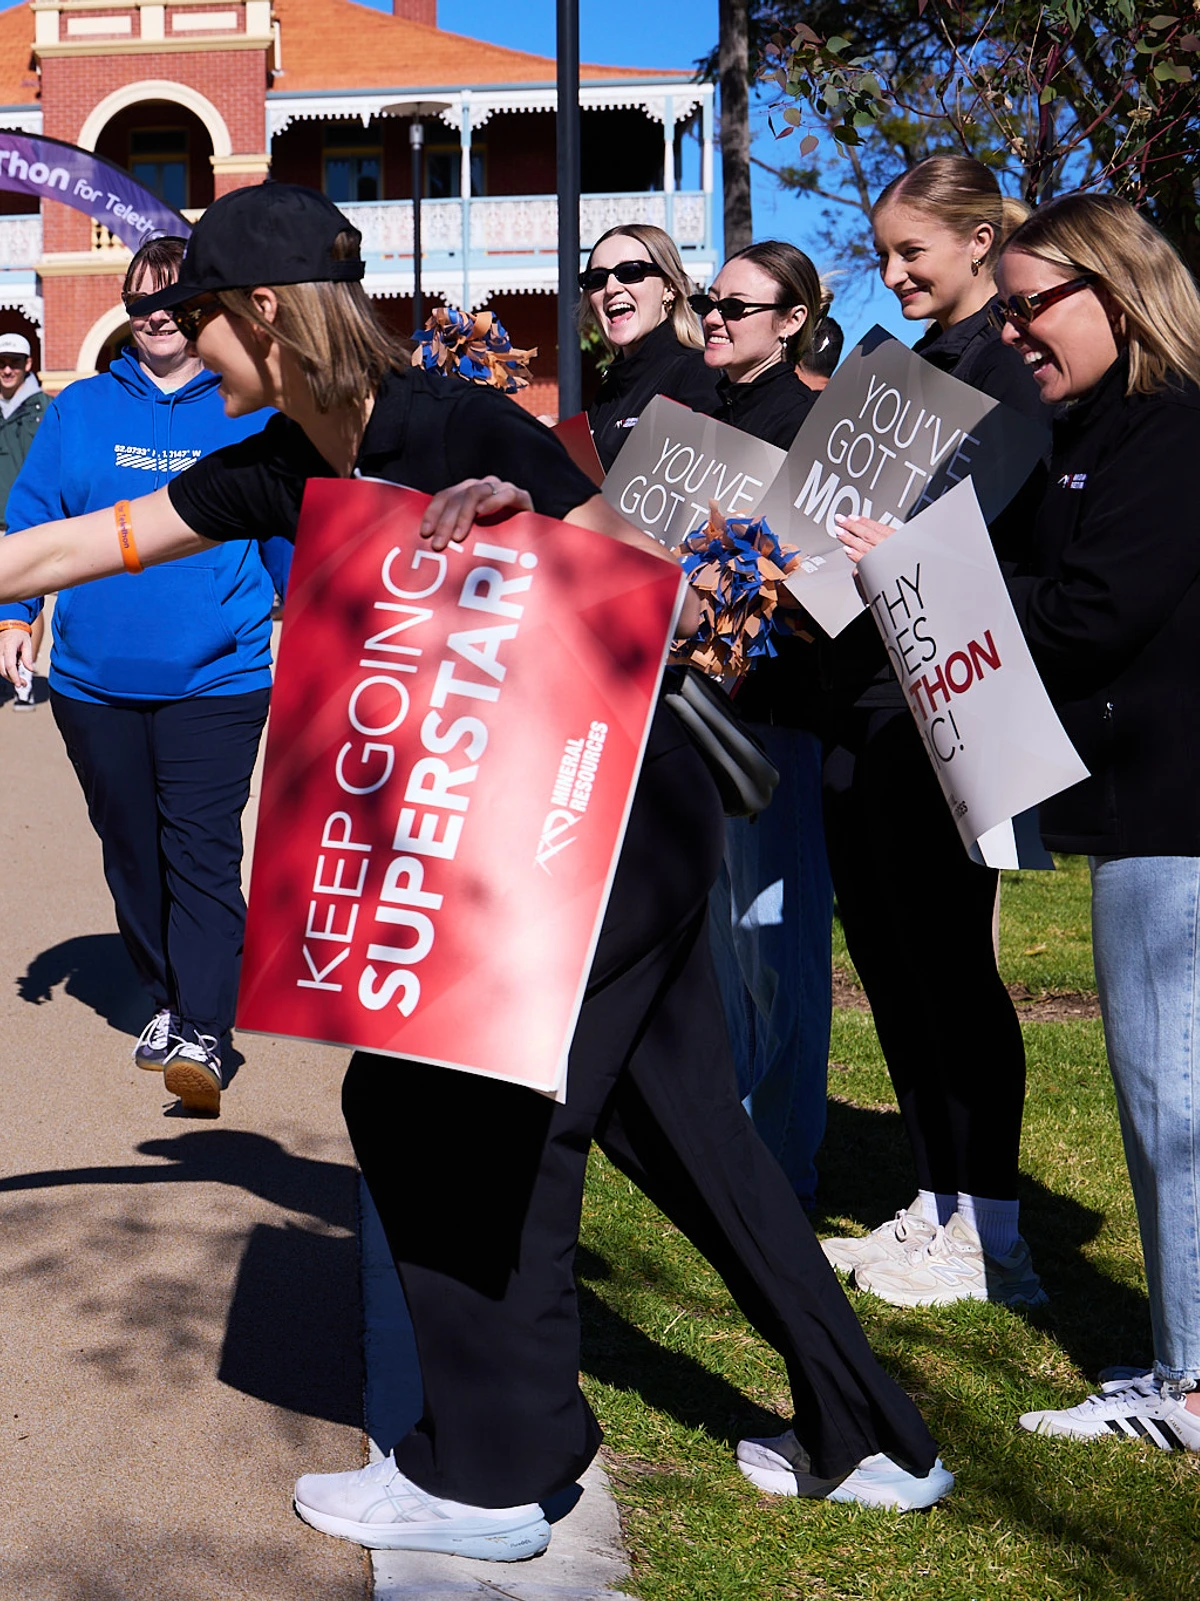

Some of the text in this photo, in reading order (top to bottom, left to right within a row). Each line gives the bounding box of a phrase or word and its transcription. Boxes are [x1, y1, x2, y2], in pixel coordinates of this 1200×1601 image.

[73, 178, 104, 203] for
[105, 192, 165, 240] Teleth
[827, 418, 896, 491] GOT
[859, 374, 981, 482] YOU'VE
[620, 475, 686, 533] GOT
[652, 437, 764, 518] YOU'VE
[870, 562, 924, 638] THY
[357, 541, 539, 1018] SUPERSTAR!
[550, 738, 586, 807] MINERAL
[568, 720, 609, 813] RESOURCES
[297, 810, 373, 992] KEEP
